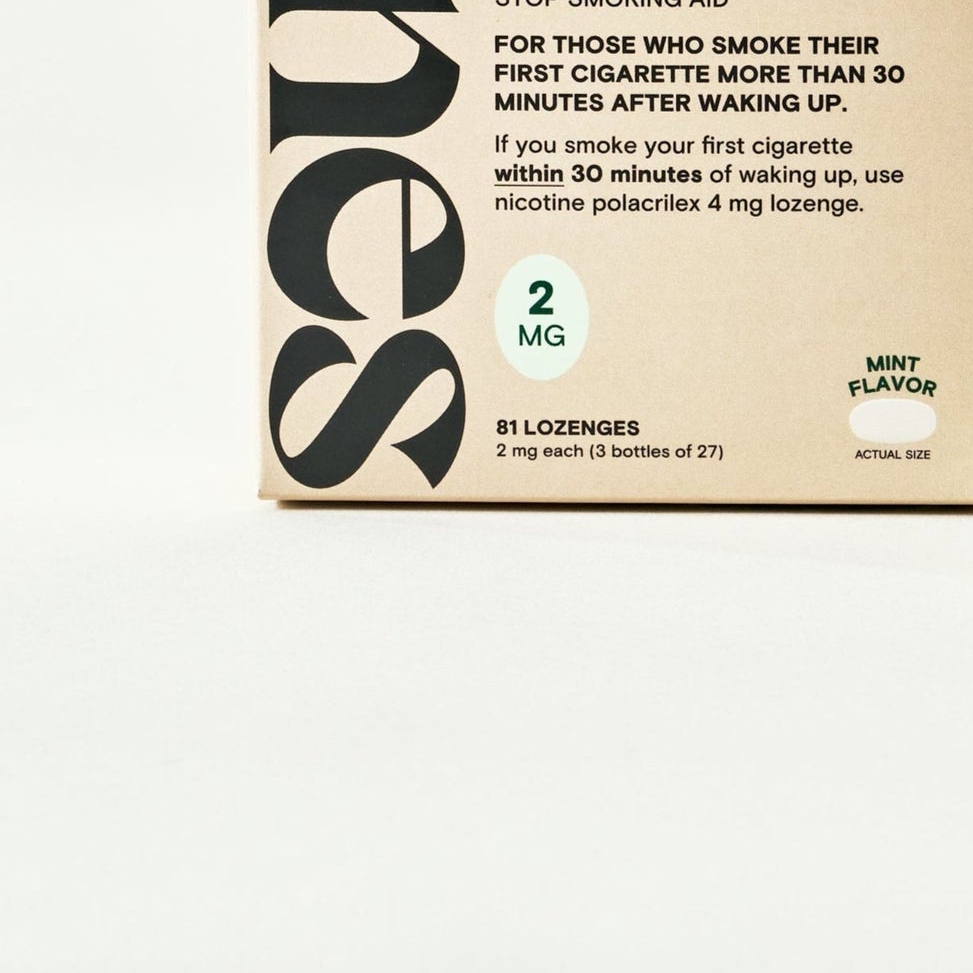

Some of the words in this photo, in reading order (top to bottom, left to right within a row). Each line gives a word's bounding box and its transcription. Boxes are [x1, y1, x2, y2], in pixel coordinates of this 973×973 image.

[495, 35, 545, 53] FOR
[552, 35, 636, 54] THOSE
[643, 36, 704, 54] WHO
[712, 36, 800, 54] SMOKE
[808, 36, 879, 54] THEIR
[495, 64, 564, 82] FIRST
[571, 65, 710, 83] CIGARETTE
[718, 65, 790, 83] MORE
[797, 65, 865, 83] THAN
[873, 65, 905, 84] 30
[495, 93, 604, 112] MINUTES
[611, 94, 690, 112] AFTER
[698, 94, 800, 112] WAKING
[808, 94, 847, 112] UP.
[496, 134, 509, 153] If
[516, 140, 556, 158] you
[565, 136, 637, 154] smoke
[644, 141, 695, 158] your
[702, 135, 745, 154] first
[752, 136, 853, 158] cigarette
[494, 164, 564, 185] within
[572, 164, 603, 182] 30
[611, 164, 702, 183] minutes
[710, 164, 732, 183] of
[739, 165, 816, 188] waking
[825, 170, 857, 188] up,
[865, 170, 904, 183] use
[496, 193, 584, 211] nicotine
[593, 194, 700, 216] polacrilex
[708, 194, 721, 211] 4
[730, 198, 762, 217] mg
[771, 194, 863, 217] lozenge.
[529, 280, 553, 315] 2
[519, 324, 565, 347] MG
[866, 355, 921, 372] MINT
[848, 375, 937, 397] FLAVOR
[496, 419, 517, 435] 81
[524, 420, 640, 436] LOZENGES
[497, 443, 506, 457] 2
[513, 447, 537, 461] mg
[543, 444, 583, 457] each
[590, 444, 606, 460] (3
[612, 444, 670, 458] bottles
[675, 444, 692, 458] of
[697, 445, 723, 461] 27)
[855, 450, 902, 459] ACTUAL
[906, 450, 931, 459] SIZE
